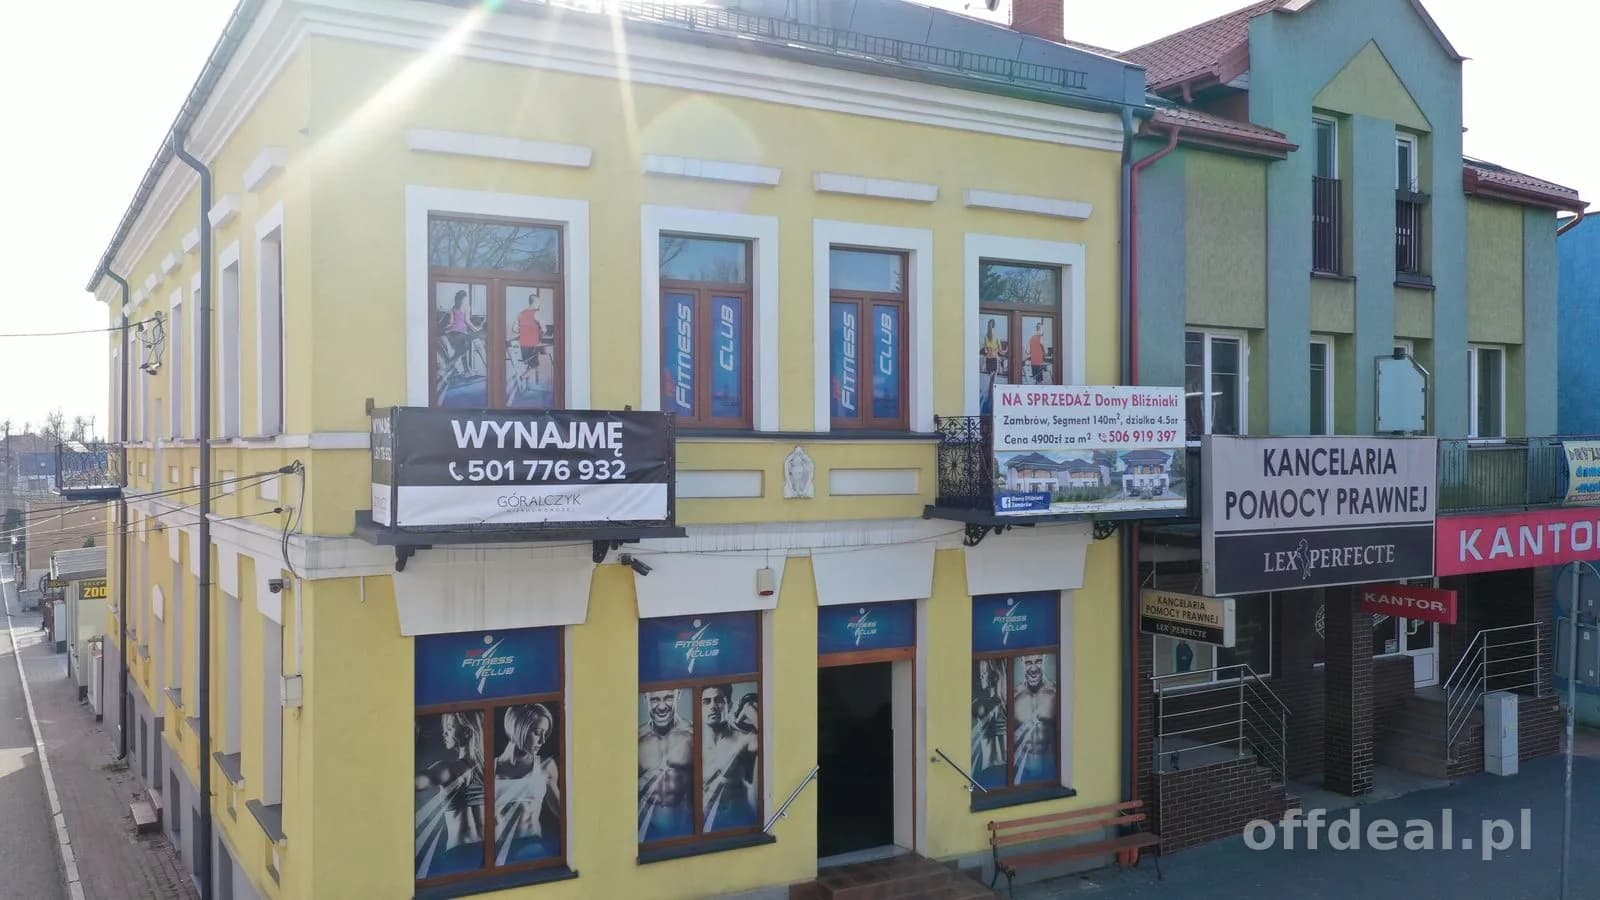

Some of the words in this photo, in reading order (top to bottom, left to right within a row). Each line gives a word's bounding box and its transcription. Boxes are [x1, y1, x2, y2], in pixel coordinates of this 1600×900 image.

[719, 304, 735, 372] CLUB
[879, 313, 893, 376] CLUB
[675, 302, 692, 409] FITNESS
[841, 311, 856, 411] FITNESS
[1002, 392, 1023, 407] NA
[1027, 390, 1092, 407] SPRZEDAŻ
[1095, 393, 1128, 410] Domy
[1132, 393, 1178, 407] Bliźniaki
[1003, 415, 1050, 427] Zambrów,
[1052, 415, 1090, 428] Segment
[451, 419, 624, 457] WYNAJMĘ
[1004, 434, 1029, 445] Cena
[1031, 433, 1062, 444] 4900zł
[1064, 436, 1075, 444] za
[1109, 430, 1130, 442] 506
[1133, 430, 1154, 442] 919
[1157, 430, 1177, 442] 397
[468, 460, 515, 481] 501
[523, 460, 570, 481] 776
[579, 459, 627, 480] 932
[1264, 447, 1398, 477] KANCELARIA
[496, 488, 582, 508] GÓRALCZYK
[1225, 487, 1330, 521] POMOCY
[1336, 485, 1428, 515] PRAWNEJ
[1459, 519, 1600, 562] KANTO
[1264, 550, 1300, 573] LEX
[1309, 544, 1396, 569] PERFECTE
[1157, 596, 1206, 611] KANCELARIA
[1364, 592, 1444, 613] KANTOR
[1145, 604, 1180, 618] POMOCY
[1182, 610, 1219, 625] PRAWNEJ
[1156, 623, 1169, 632] LEX
[1171, 625, 1208, 638] PERFECTE
[462, 655, 515, 668] FITNESS
[481, 667, 515, 677] CLUB
